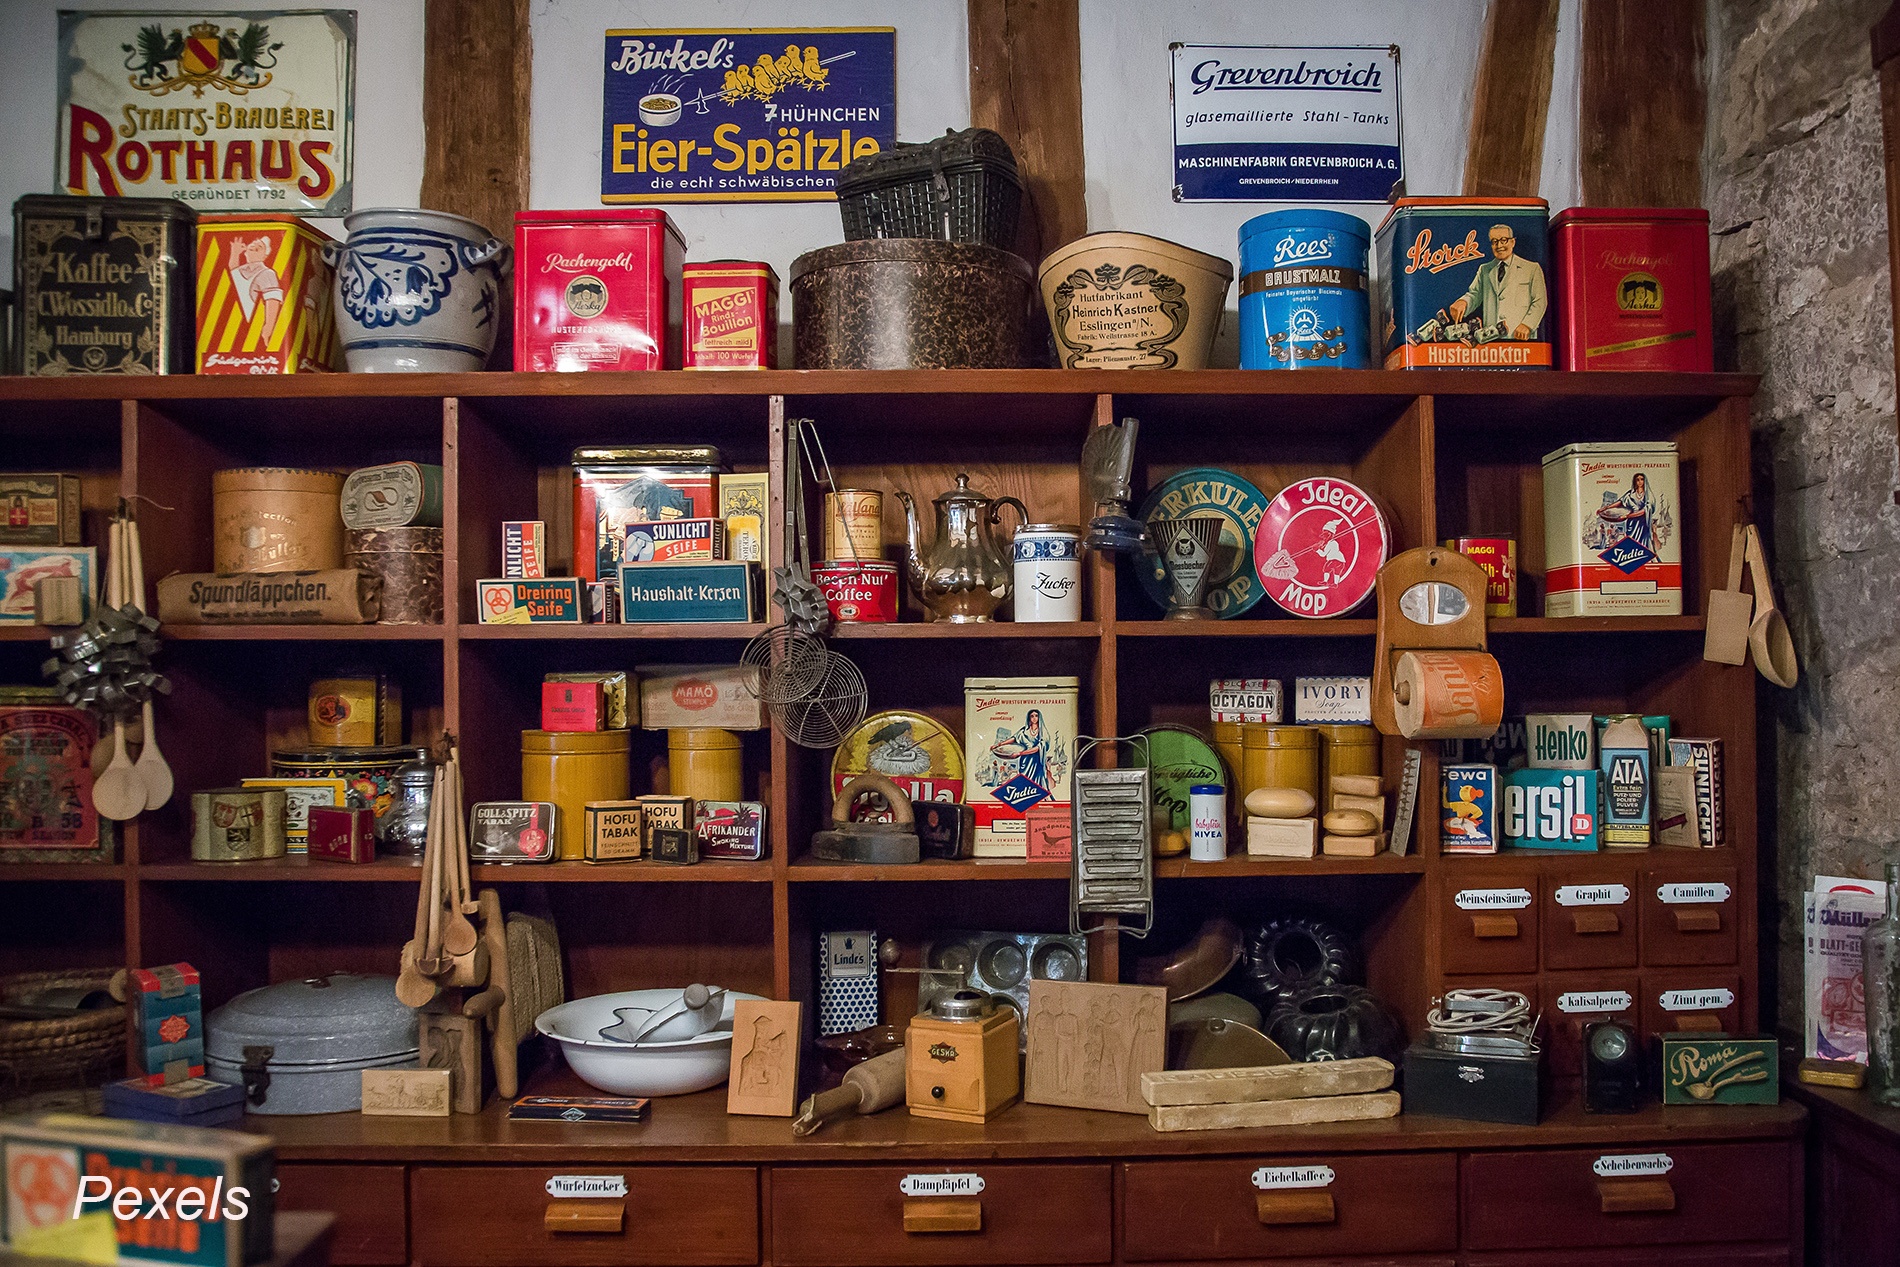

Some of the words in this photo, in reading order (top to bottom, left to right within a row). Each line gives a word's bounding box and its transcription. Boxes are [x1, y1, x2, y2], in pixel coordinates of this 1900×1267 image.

[611, 37, 734, 75] Birkel's
[1190, 60, 1382, 95] Grevenbroich
[118, 102, 335, 138] STAATS-BRAUEREI
[764, 104, 778, 122] 7
[780, 104, 880, 122] HÜHNCHEN
[1185, 110, 1294, 127] glasemaillierte
[67, 102, 334, 198] ROTHAUS
[1179, 156, 1287, 169] MASCHINENFABRIK
[1290, 157, 1373, 168] GREVENBROICH
[650, 175, 674, 189] die
[680, 175, 714, 189] echt
[718, 174, 836, 188] schwäbischen
[172, 187, 250, 200] GEGRÜNDET
[256, 188, 286, 200] 1792
[1273, 234, 1329, 263] Rees
[1405, 228, 1484, 274] Storck
[57, 252, 133, 284] Kaffee
[541, 252, 633, 272] Rachengold
[1265, 268, 1341, 287] BRUSTMALZ
[1079, 290, 1144, 303] Hutfabrikant
[1072, 304, 1112, 320] Heinrich
[1113, 302, 1160, 317] Kastner
[702, 316, 753, 338] Bouillon
[1079, 320, 1132, 333] Esslingen
[56, 325, 133, 349] Hamburg
[1428, 345, 1531, 364] Hustendoktor
[1298, 481, 1368, 518] Ideal
[652, 522, 708, 541] SUNLICHT
[665, 539, 699, 557] SEIFE
[1467, 546, 1495, 555] MAGGI
[1611, 547, 1646, 564] India
[523, 539, 539, 577] SEIFE
[631, 585, 741, 602] Haushalt-Kerzen
[1031, 571, 1076, 599] Zucker
[517, 584, 573, 604] Dreiring
[825, 588, 873, 601] Coffee
[1279, 582, 1327, 614] Mop
[527, 601, 564, 616] Seife
[675, 683, 715, 698] MAMÖ
[1303, 685, 1365, 700] IVORY
[976, 698, 1000, 709] India
[1212, 694, 1274, 710] OCTAGON
[1314, 697, 1345, 713] Soap
[1535, 725, 1588, 761] Henko
[1610, 758, 1645, 785] ATA
[1003, 785, 1038, 801] India
[1693, 746, 1712, 843] SUNLICHT
[645, 806, 677, 817] HOFU
[1504, 775, 1586, 839] ersil
[603, 814, 636, 825] HOFU
[643, 819, 679, 830] TABAK
[601, 827, 638, 839] TABAK
[698, 823, 756, 840] AFRIKANDER
[711, 836, 740, 847] SMOKING
[1459, 891, 1527, 905] Weinsteinsäure
[1575, 888, 1612, 901] Graphit
[1672, 887, 1715, 898] Camillen
[1567, 995, 1624, 1009] Kalisalpeter
[1672, 994, 1697, 1006] Zimt
[1699, 995, 1724, 1007] gem.
[1670, 1041, 1738, 1087] Roma
[1600, 1157, 1668, 1171] Scheibenwachs
[912, 1177, 970, 1193] Dampfäpfel
[1264, 1170, 1326, 1184] Eichelkaffee
[554, 1179, 620, 1193] Würfelzucker
